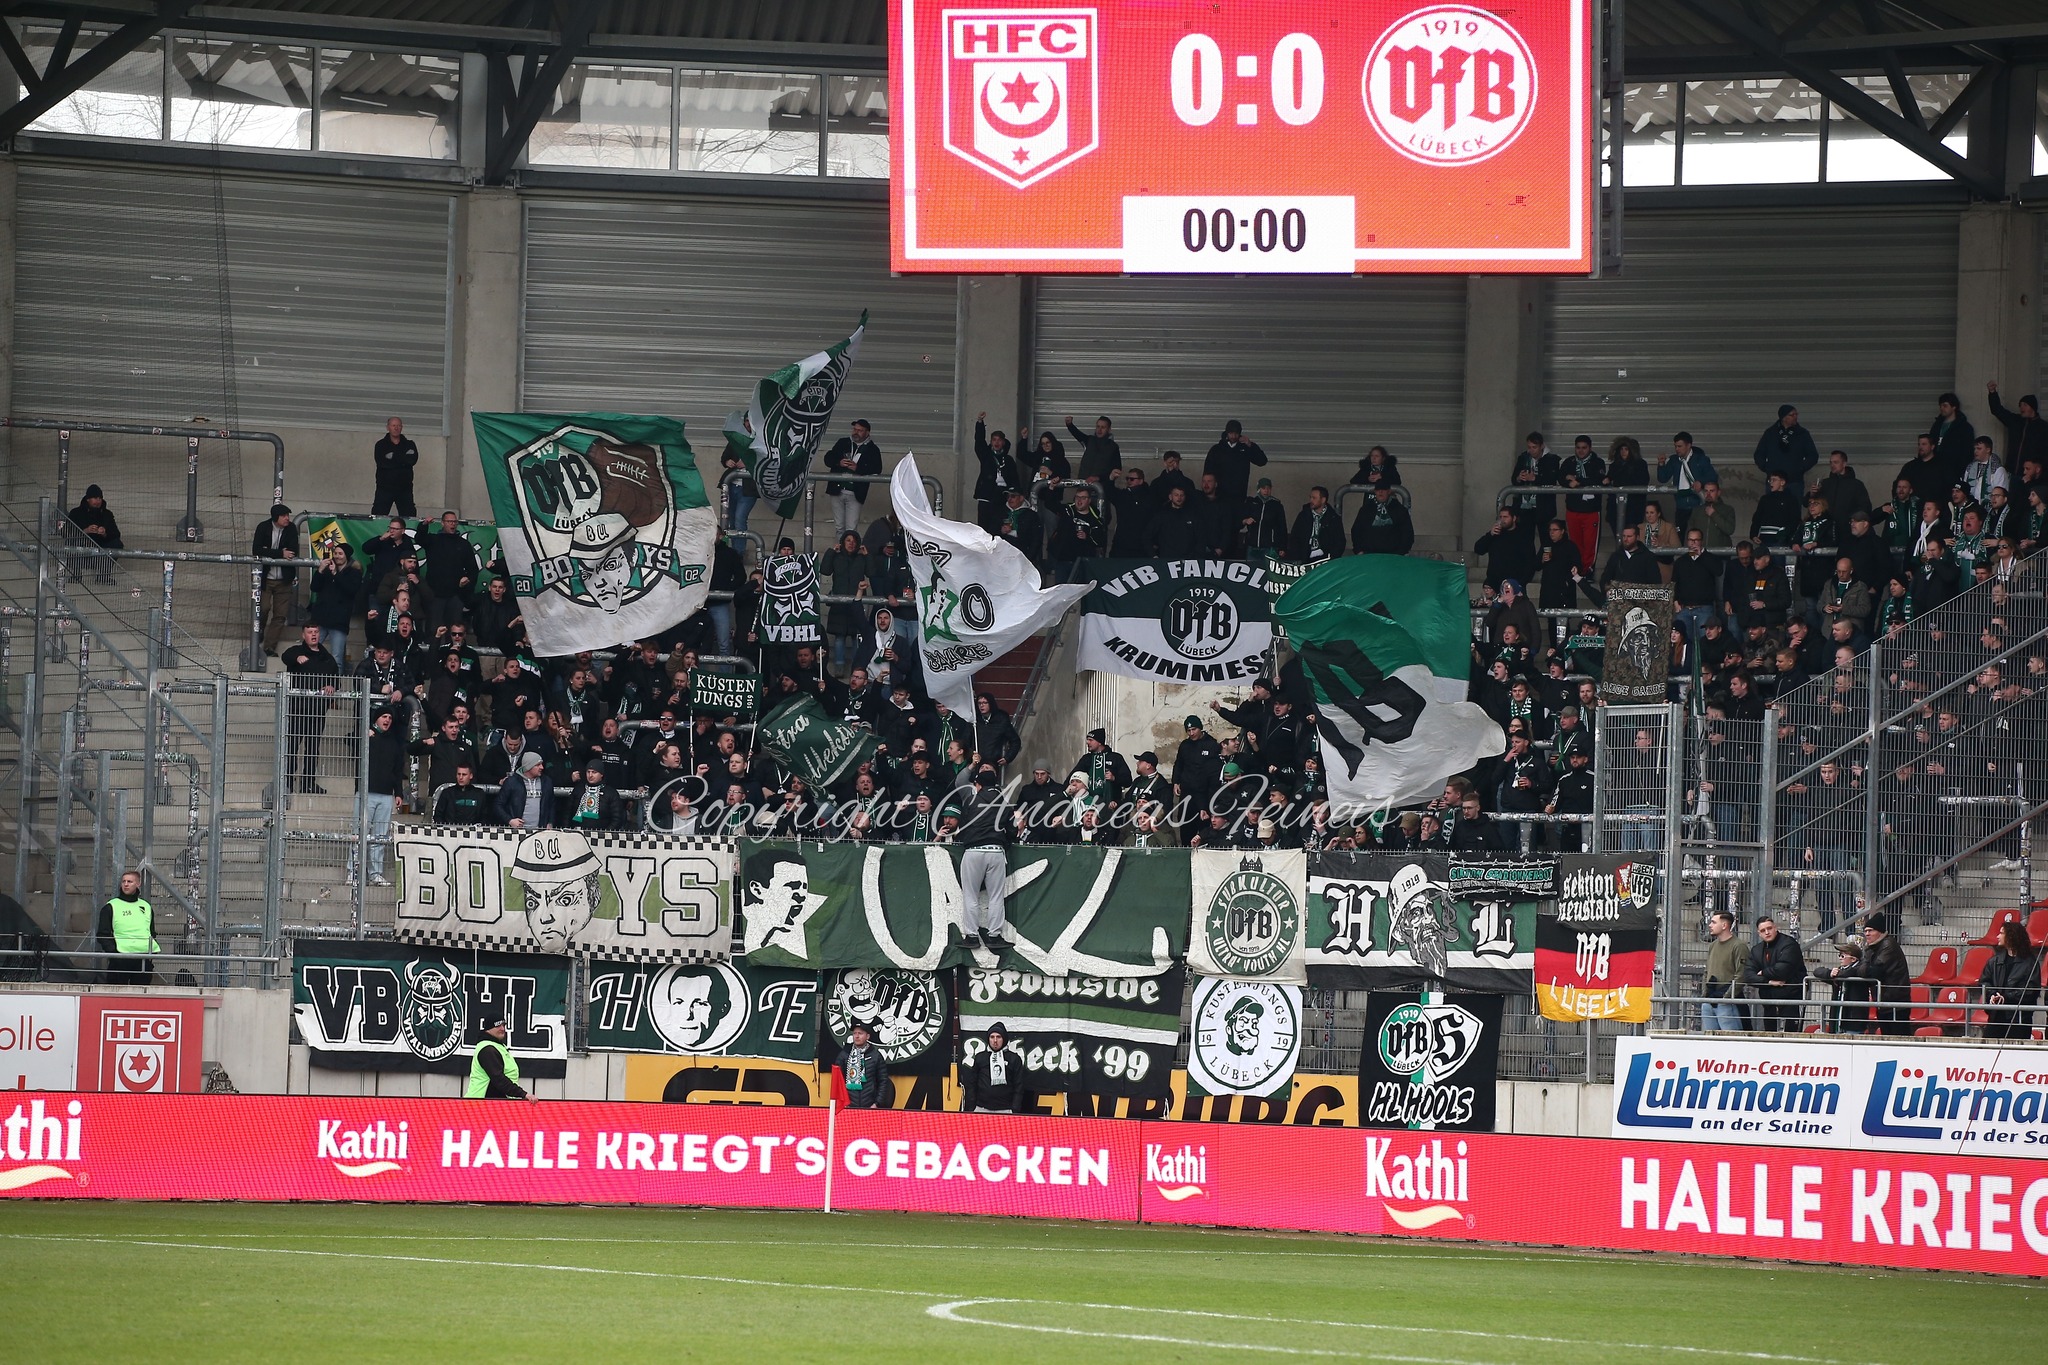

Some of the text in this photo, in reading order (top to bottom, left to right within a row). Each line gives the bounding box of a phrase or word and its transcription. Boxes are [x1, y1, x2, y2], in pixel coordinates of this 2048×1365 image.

[962, 23, 1079, 54] HFC
[1420, 20, 1479, 38] 1919
[1170, 31, 1325, 126] 0:0
[1384, 44, 1517, 132] VfB
[1407, 133, 1489, 157] LÜBECK
[1182, 207, 1307, 252] 00:00
[522, 453, 600, 516] VfB
[685, 569, 700, 582] 02
[778, 562, 798, 573] 1919
[1101, 559, 1269, 597] VfB FANCL
[1269, 560, 1306, 577] ULTRAS
[516, 579, 531, 592] 20
[1189, 588, 1214, 597] 1919
[764, 624, 821, 642] VBHL
[1169, 598, 1232, 644] VfB
[1179, 644, 1219, 656] LÜBECK
[696, 674, 757, 692] KÜSTEN
[694, 690, 743, 708] JUNGS
[746, 694, 754, 709] 1919
[1218, 875, 1290, 910] SUBKULTUR
[1401, 875, 1420, 892] 1919
[1631, 875, 1653, 899] VfB
[1230, 907, 1272, 942] VfB
[1576, 932, 1611, 984] VfB
[1550, 976, 1629, 1018] LÜBECK
[1399, 1009, 1418, 1019] 1919
[111, 1019, 172, 1040] HFC
[827, 999, 943, 1061] BAD WARTAU
[1201, 1034, 1289, 1047] 19 19
[1387, 1021, 1428, 1060] VfB
[1210, 1056, 1273, 1082] LÜBECK
[1392, 1059, 1420, 1070] LÜBECK
[1696, 1059, 1839, 1077] Wohn-Centrum
[1369, 1082, 1402, 1122] HL
[1402, 1082, 1475, 1124] HOOLS
[1617, 1052, 1841, 1129] Lührmann
[1861, 1059, 2048, 1140] Lührma
[0, 1099, 83, 1160] thi
[317, 1120, 409, 1160] Kathi
[1700, 1117, 1834, 1135] an der Saline
[1950, 1128, 2048, 1144] an der Sa
[441, 1129, 580, 1170] HALLE
[844, 1139, 1109, 1187] GEBACKEN
[1145, 1144, 1206, 1184] Kathi
[1365, 1137, 1469, 1201] Kathi
[1621, 1156, 1823, 1240] HALLE
